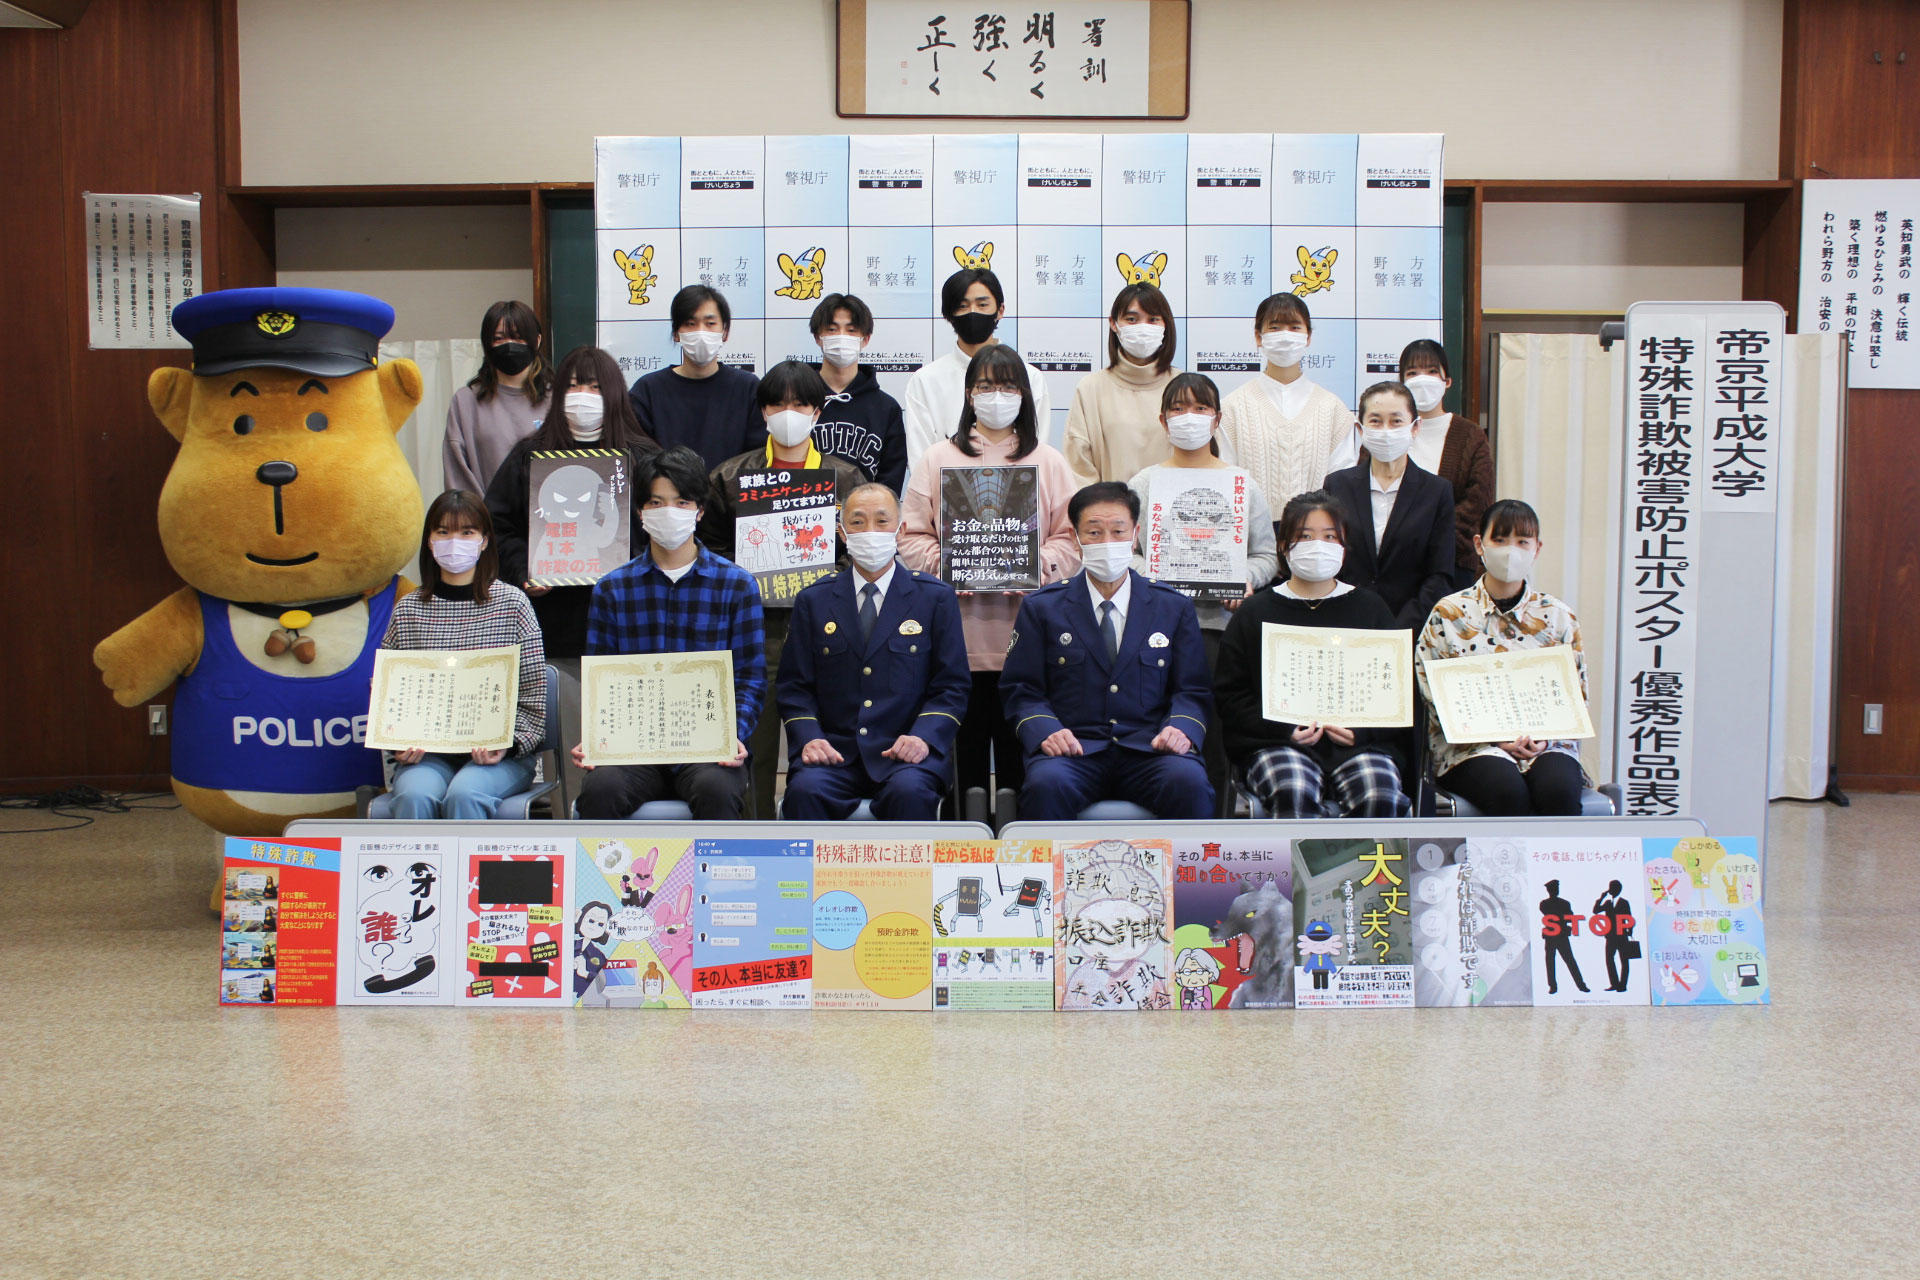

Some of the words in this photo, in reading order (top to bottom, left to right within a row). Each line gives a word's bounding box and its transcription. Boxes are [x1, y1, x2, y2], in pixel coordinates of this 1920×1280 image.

[917, 15, 956, 96] 正しく
[972, 13, 1009, 82] 強く
[1023, 12, 1055, 100] 明るく
[1080, 18, 1107, 83] 署訓
[617, 173, 660, 188] 警視庁
[785, 171, 828, 186] 警視庁
[954, 170, 997, 185] 警視庁
[1041, 179, 1079, 187] けいしちょう
[1123, 169, 1166, 184] 警視庁
[1210, 179, 1248, 187] 警視庁
[1292, 170, 1335, 184] 警視庁
[1820, 211, 1835, 283] われら野方の
[1846, 219, 1861, 280] 築く理想の
[1872, 210, 1888, 296] 燃ゆるひとみの
[1899, 218, 1913, 280] 英知勇武の
[700, 273, 748, 287] 警察署
[867, 272, 917, 287] 警察署
[1036, 271, 1086, 286] 警察署
[1205, 271, 1255, 286] 警察署
[1374, 273, 1424, 288] 警察署
[1819, 296, 1832, 332] 治安の
[1895, 292, 1910, 342] 輝く伝統
[1869, 308, 1883, 369] 決意は堅し
[619, 356, 661, 370] 警視庁
[1041, 363, 1077, 371] 警視庁
[1210, 363, 1248, 371] けいしちょう
[1711, 328, 1770, 498] 帝京平成大学
[813, 421, 883, 468] UTIC
[739, 471, 791, 489] 家族との
[738, 481, 834, 502] コミュニケーション
[772, 494, 835, 511] 足りてますか?
[545, 522, 577, 538] 電話
[952, 518, 1029, 532] お金や品物を
[951, 534, 1029, 544] 受け取るだけの仕事
[1150, 503, 1162, 574] あなたのそばに
[546, 541, 575, 556] 1本
[951, 545, 1029, 555] そんな都合のいい話
[537, 558, 602, 575] 詐欺の元
[951, 557, 1029, 567] 簡単に信じないで!
[1383, 662, 1392, 690] 表彰状
[705, 689, 716, 722] 表彰状
[233, 714, 369, 748] POLICE
[251, 843, 318, 867] 特殊詐欺
[816, 844, 931, 864] 特殊詐欺に注意!
[1178, 842, 1273, 862] その声は、本当に
[1532, 851, 1638, 863] その電話、信じちゃダメ!!
[1066, 868, 1112, 895] 詐欺
[1176, 864, 1289, 884] 知り合いですか?
[409, 873, 436, 923] オレ
[1358, 843, 1409, 964] 大丈夫?
[877, 928, 920, 937] 預貯金詐欺
[1059, 917, 1170, 948] 振込詐欺
[1457, 862, 1479, 989] それは詐欺です
[1541, 914, 1636, 937] STOP
[1687, 935, 1728, 945] 大切に!!
[605, 961, 627, 969] ATM
[1068, 952, 1110, 970] 口座
[698, 959, 807, 989] その人、本当に友達?
